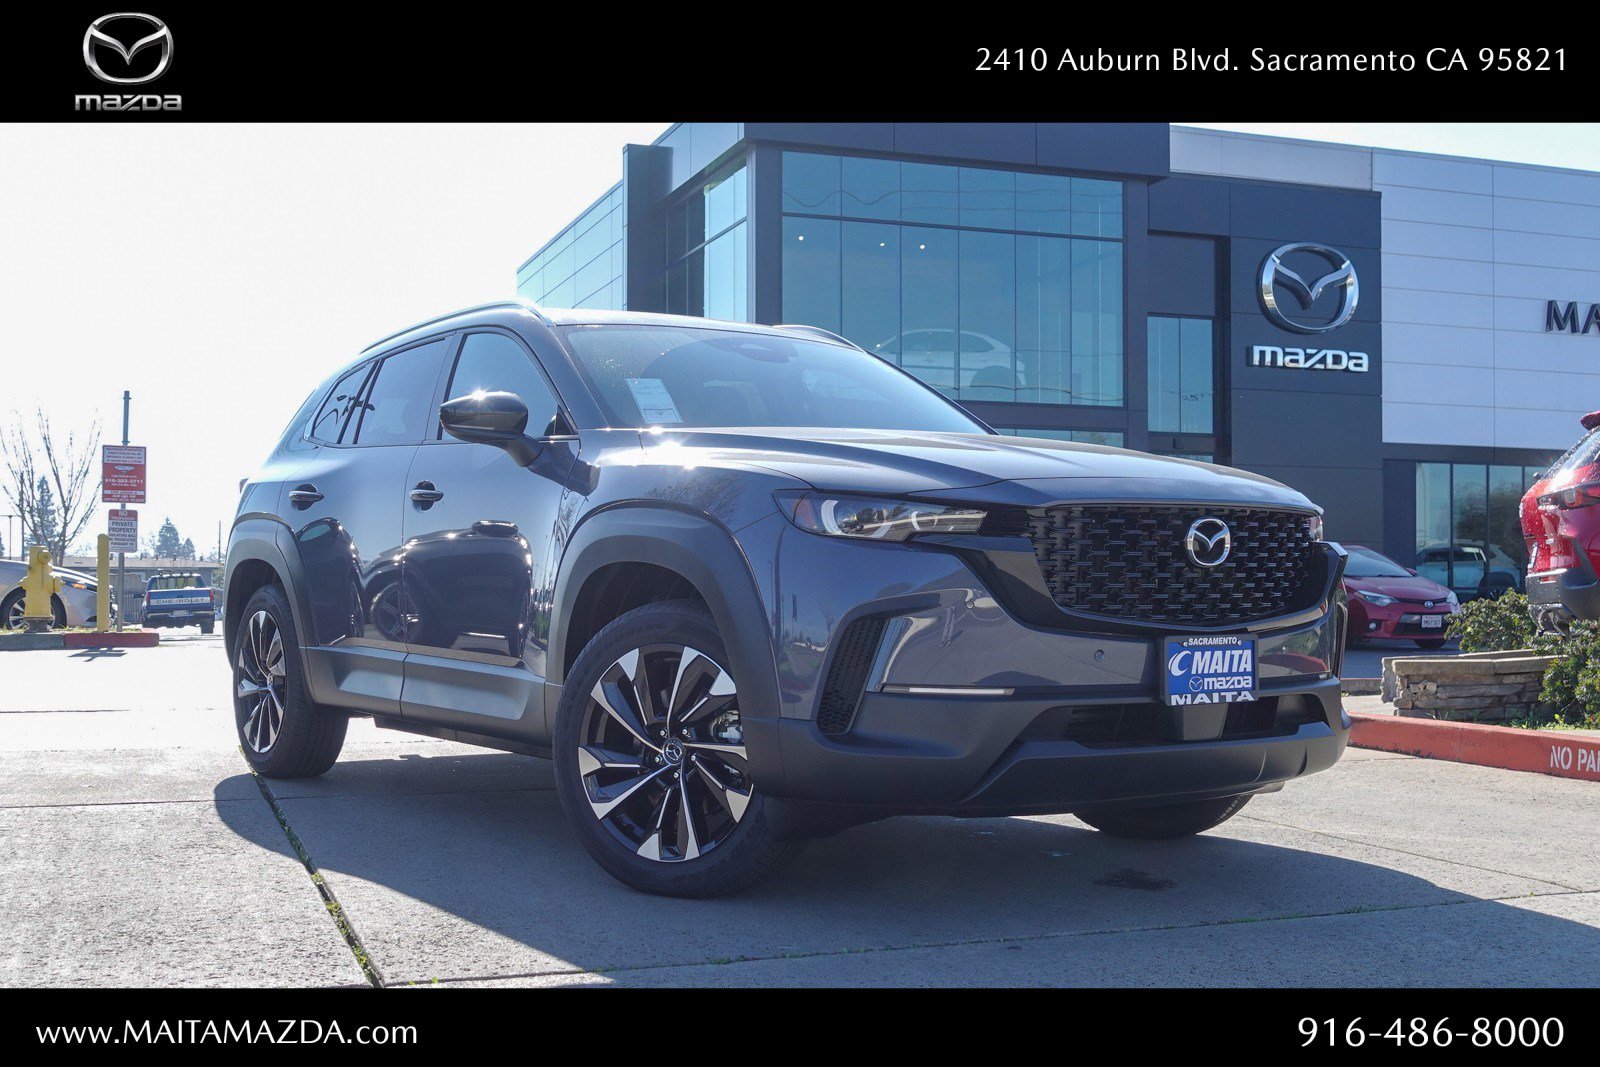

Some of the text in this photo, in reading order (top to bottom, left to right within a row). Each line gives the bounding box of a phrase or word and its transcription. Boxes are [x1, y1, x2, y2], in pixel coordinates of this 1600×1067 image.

[111, 520, 134, 528] PRIVATE
[1188, 636, 1238, 646] SACRAMENTO
[1191, 649, 1252, 675] MAITA
[1170, 690, 1255, 706] MAITA
[1550, 745, 1600, 773] NO PA
